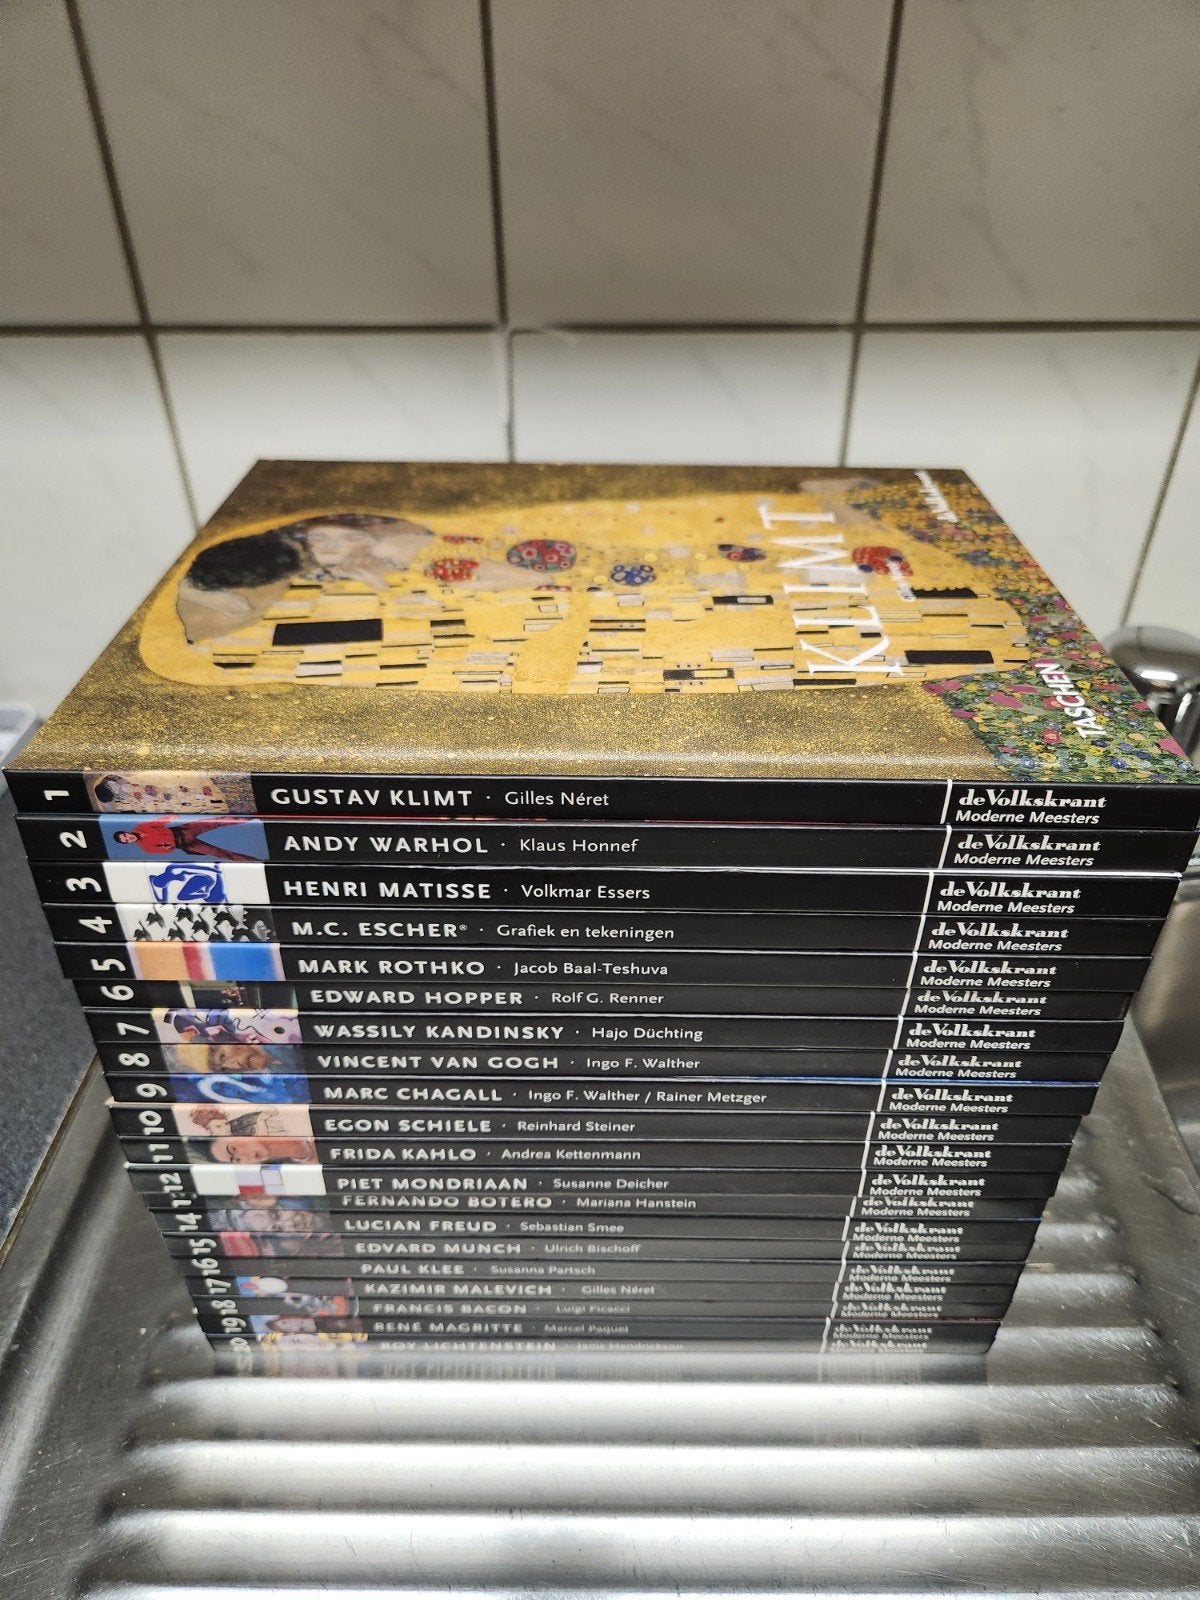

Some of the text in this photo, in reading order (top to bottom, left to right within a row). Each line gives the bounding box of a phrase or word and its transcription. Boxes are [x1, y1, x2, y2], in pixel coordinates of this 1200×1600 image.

[759, 504, 904, 676] KLIMT
[1036, 662, 1107, 738] TASCHEN
[44, 790, 70, 800] 1
[271, 788, 609, 807] GUSTAV KLIMT Gilles Néret
[956, 810, 1100, 824] Moderne Meesters
[60, 830, 87, 848] 2
[284, 835, 639, 853] ANDY WARHOL Klaus Honnef
[954, 853, 1094, 866] Moderne Meesters
[66, 877, 102, 892] 3
[283, 881, 650, 899] HENRI MATISSE Volkmar Essers
[937, 901, 1075, 914] Moderne Meesters
[78, 916, 113, 934] 4
[292, 922, 348, 937] M.C.
[497, 924, 555, 937] Grafiek
[560, 928, 579, 938] en
[585, 926, 674, 942] tekeningen
[928, 939, 1062, 951] Moderne Meesters
[91, 959, 126, 972] 5
[299, 960, 668, 976] MARK ROTHKO Jacob Baal-Teshuva
[920, 976, 1051, 988] Moderne Meesters
[101, 985, 134, 1001] 6
[310, 990, 664, 1005] EDWARD HOPPER Rolf G. Renner
[914, 1005, 1041, 1016] Moderne Meesters
[117, 1022, 150, 1036] 7
[313, 1024, 703, 1042] WASSILY KANDINSKY Hajo Düchting
[906, 1038, 1031, 1050] Moderne Meesters
[118, 1052, 150, 1067] 8
[317, 1055, 700, 1071] VINCENT VAN GOGH Ingo F. Walther
[896, 1068, 1017, 1078] Moderne Meesters
[136, 1083, 168, 1097] 9
[324, 1087, 388, 1101] MARC
[396, 1088, 502, 1101] CHAGALL
[528, 1090, 561, 1103] Ingo
[566, 1091, 579, 1101] F.
[583, 1089, 640, 1103] Walther
[656, 1091, 703, 1103] Rainer
[707, 1092, 767, 1105] Metzger
[889, 1102, 1008, 1113] Moderne Meesters
[139, 1110, 164, 1135] 10
[325, 1119, 635, 1133] EGON SCHIELE Reinhard Steiner
[878, 1131, 994, 1141] Moderne Meesters
[148, 1143, 173, 1162] 11
[330, 1148, 641, 1161] FRIDA KAHLO Andrea Kettenmann
[874, 1157, 987, 1167] Moderne Meesters
[159, 1173, 183, 1193] 12
[337, 1178, 669, 1191] PIET MONDRIAAN Susanne Deicher
[870, 1187, 981, 1196] Moderne Meesters
[343, 1196, 696, 1209] FERNANDO BOTERO Mariana Hanstein
[176, 1213, 202, 1231] 14
[345, 1219, 624, 1232] LUCIAN FREUD Sebastian Smee
[189, 1238, 217, 1254] 15
[355, 1242, 436, 1254] EDVARD
[444, 1243, 521, 1254] MUNCH
[192, 1258, 221, 1276] 16
[361, 1264, 411, 1274] PAUL
[418, 1264, 464, 1274] KLEE
[206, 1278, 231, 1294] 17
[364, 1284, 446, 1294] KAZIMIR
[454, 1284, 552, 1296] MALEVICH
[211, 1300, 238, 1315] 18
[221, 1318, 246, 1333] 19
